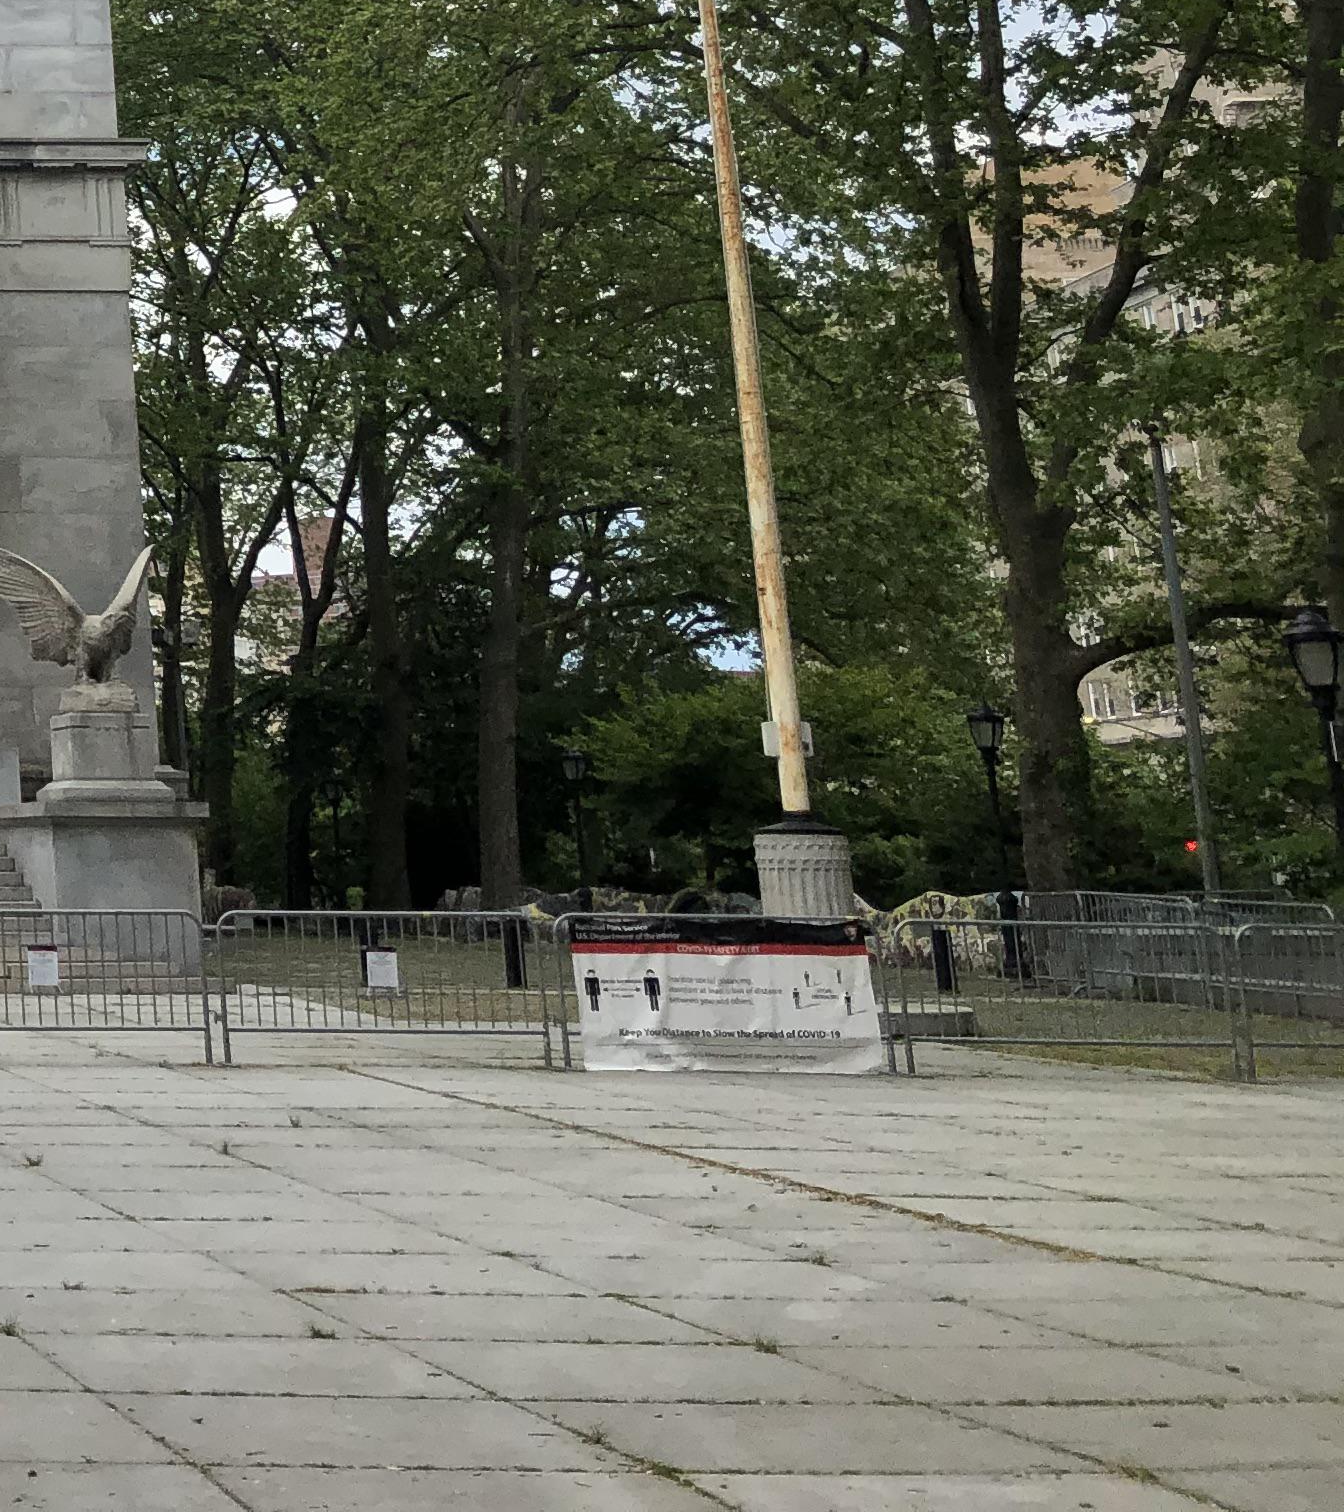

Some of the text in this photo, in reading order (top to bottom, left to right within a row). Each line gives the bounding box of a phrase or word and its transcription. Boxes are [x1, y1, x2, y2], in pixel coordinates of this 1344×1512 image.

[702, 1029, 712, 1038] to
[713, 1029, 735, 1038] Slow
[737, 1030, 752, 1038] the
[752, 1030, 785, 1040] Spread
[786, 1029, 796, 1038] of
